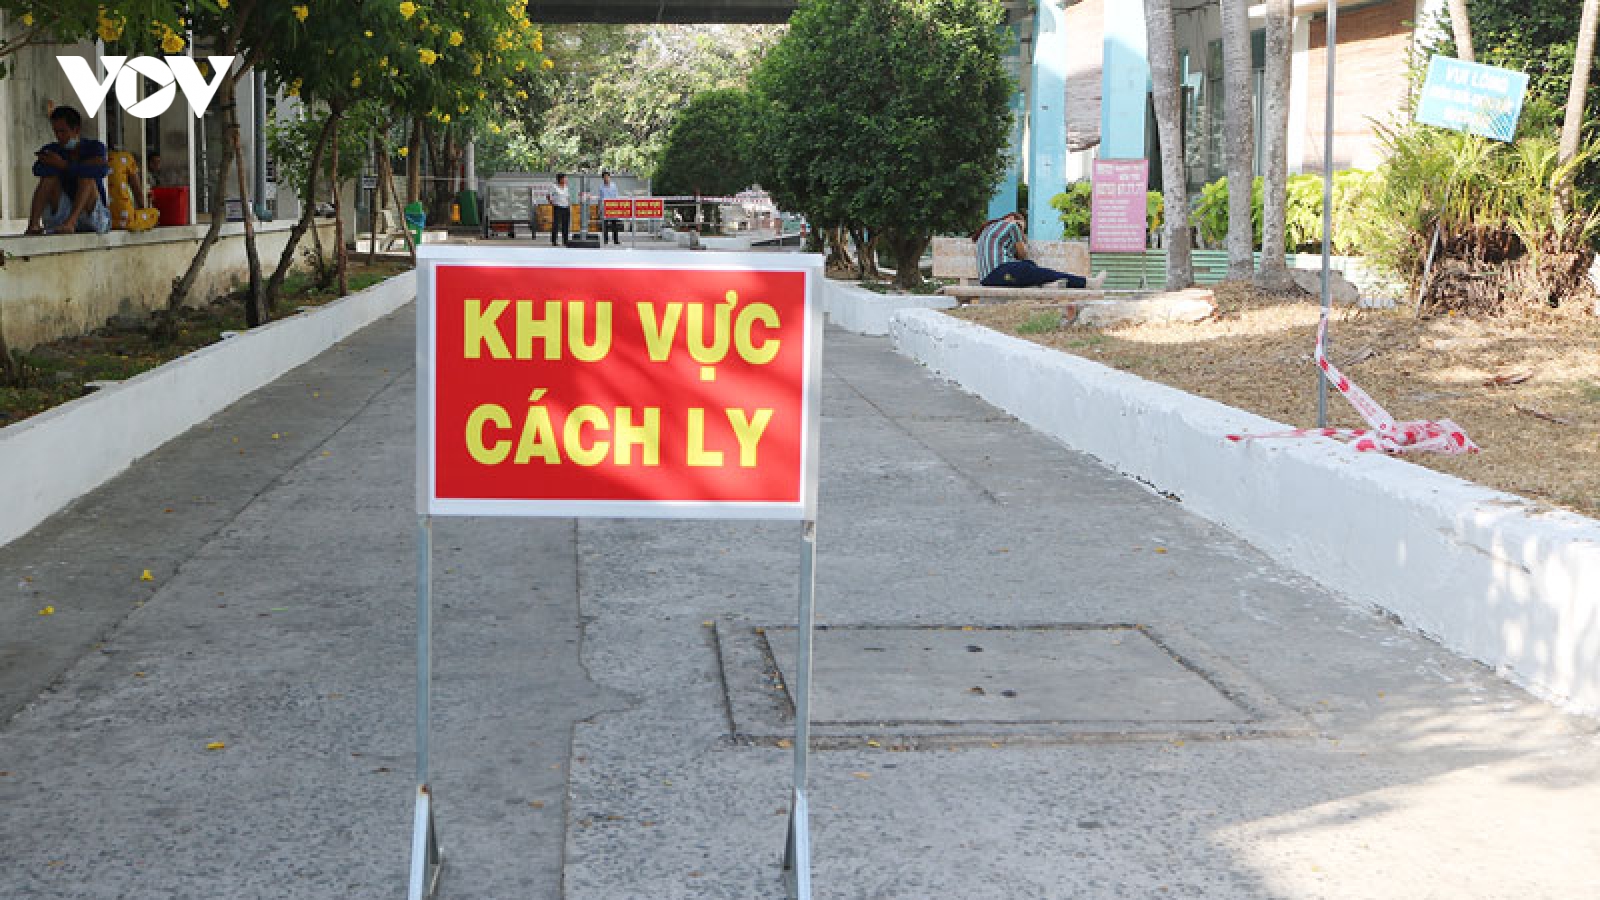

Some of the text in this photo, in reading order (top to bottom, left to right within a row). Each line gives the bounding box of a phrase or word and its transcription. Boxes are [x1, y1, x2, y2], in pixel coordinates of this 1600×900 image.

[464, 290, 781, 381] KHU VỰC
[465, 388, 774, 467] CÁCH LY
